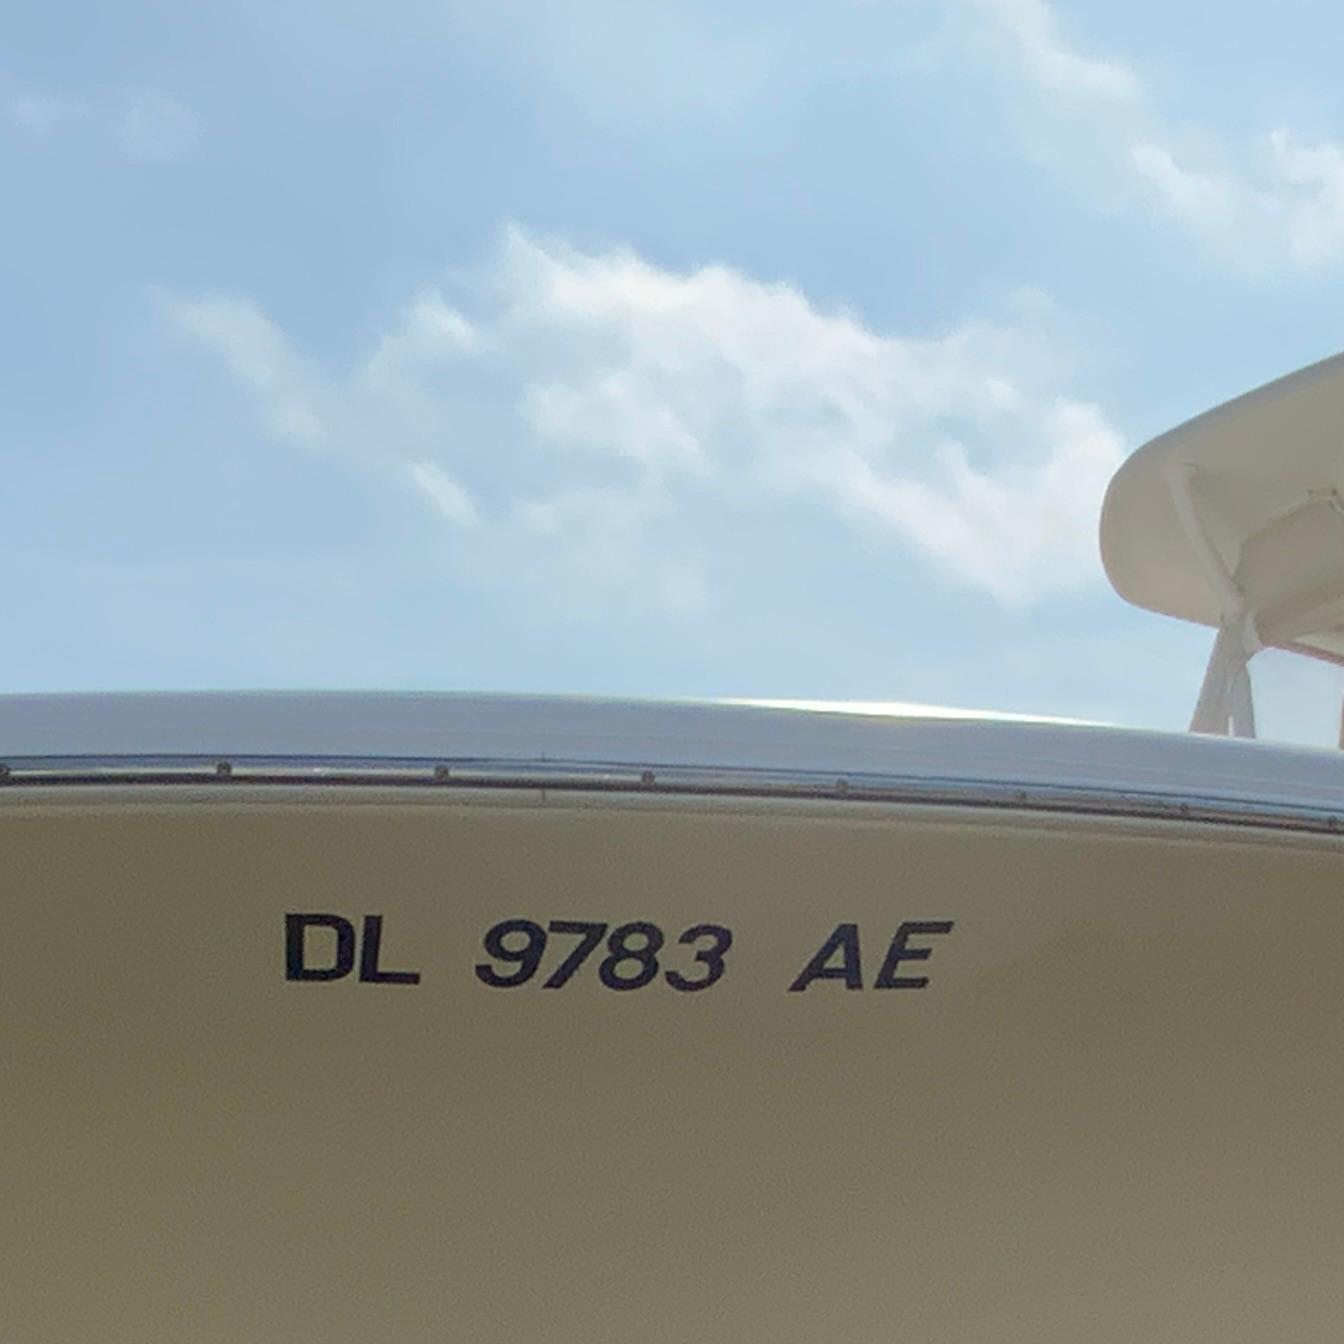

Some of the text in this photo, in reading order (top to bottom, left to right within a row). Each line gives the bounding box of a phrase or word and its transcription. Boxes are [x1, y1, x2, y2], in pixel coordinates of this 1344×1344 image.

[284, 913, 955, 993] DL 9783 AE
